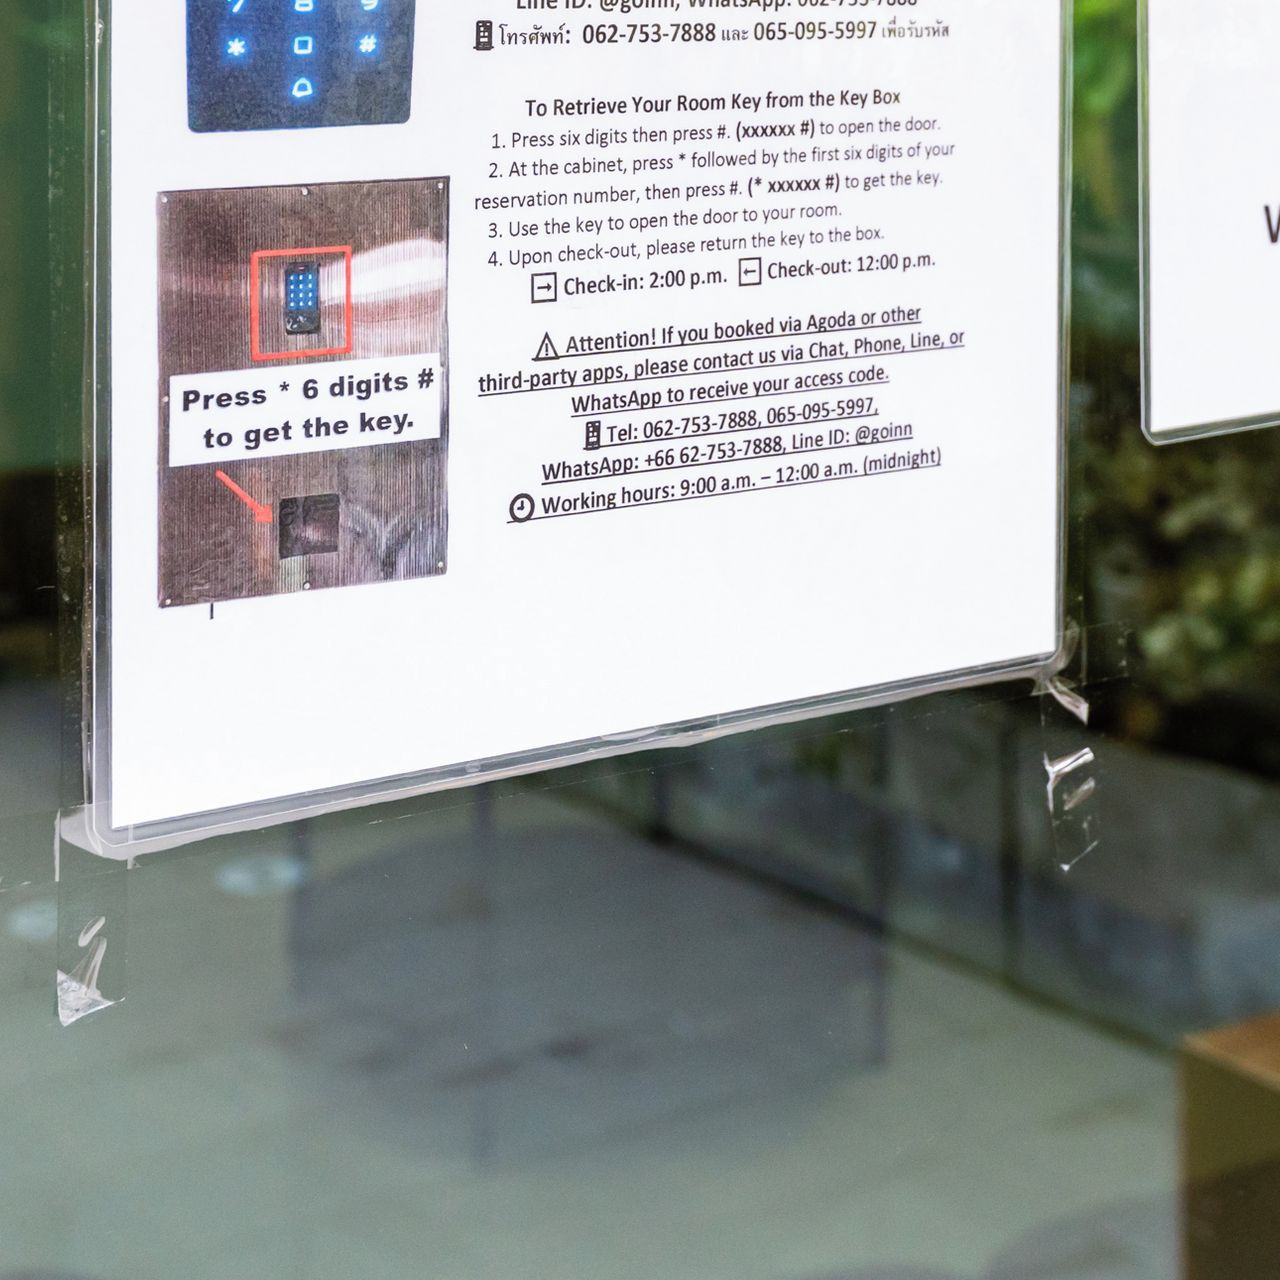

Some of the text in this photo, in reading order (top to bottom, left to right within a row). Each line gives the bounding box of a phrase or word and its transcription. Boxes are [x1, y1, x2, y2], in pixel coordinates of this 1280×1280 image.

[583, 23, 716, 44] 062-753-7888
[754, 21, 877, 41] 065-095-5997
[525, 89, 900, 116] To Retrieve Your Room Key from the Key Box
[492, 133, 506, 149] 1.
[512, 132, 554, 148] Press
[559, 130, 580, 146] six
[585, 128, 627, 148] digits
[632, 126, 667, 143] then
[673, 128, 713, 145] press
[717, 125, 730, 139] #.
[800, 119, 815, 139] #)
[819, 122, 834, 135] to
[838, 122, 874, 137] open
[878, 118, 901, 132] the
[905, 116, 940, 131] door.
[564, 253, 935, 295] Check-in: 2:00 p.m. Check-out: 12:00 p.m.
[566, 306, 921, 353] Attention! If you booked via Agoda or other
[183, 389, 267, 412] Press
[303, 379, 318, 399] 6
[329, 372, 408, 400] digits
[418, 368, 434, 389] #
[203, 412, 413, 450] to get the key.
